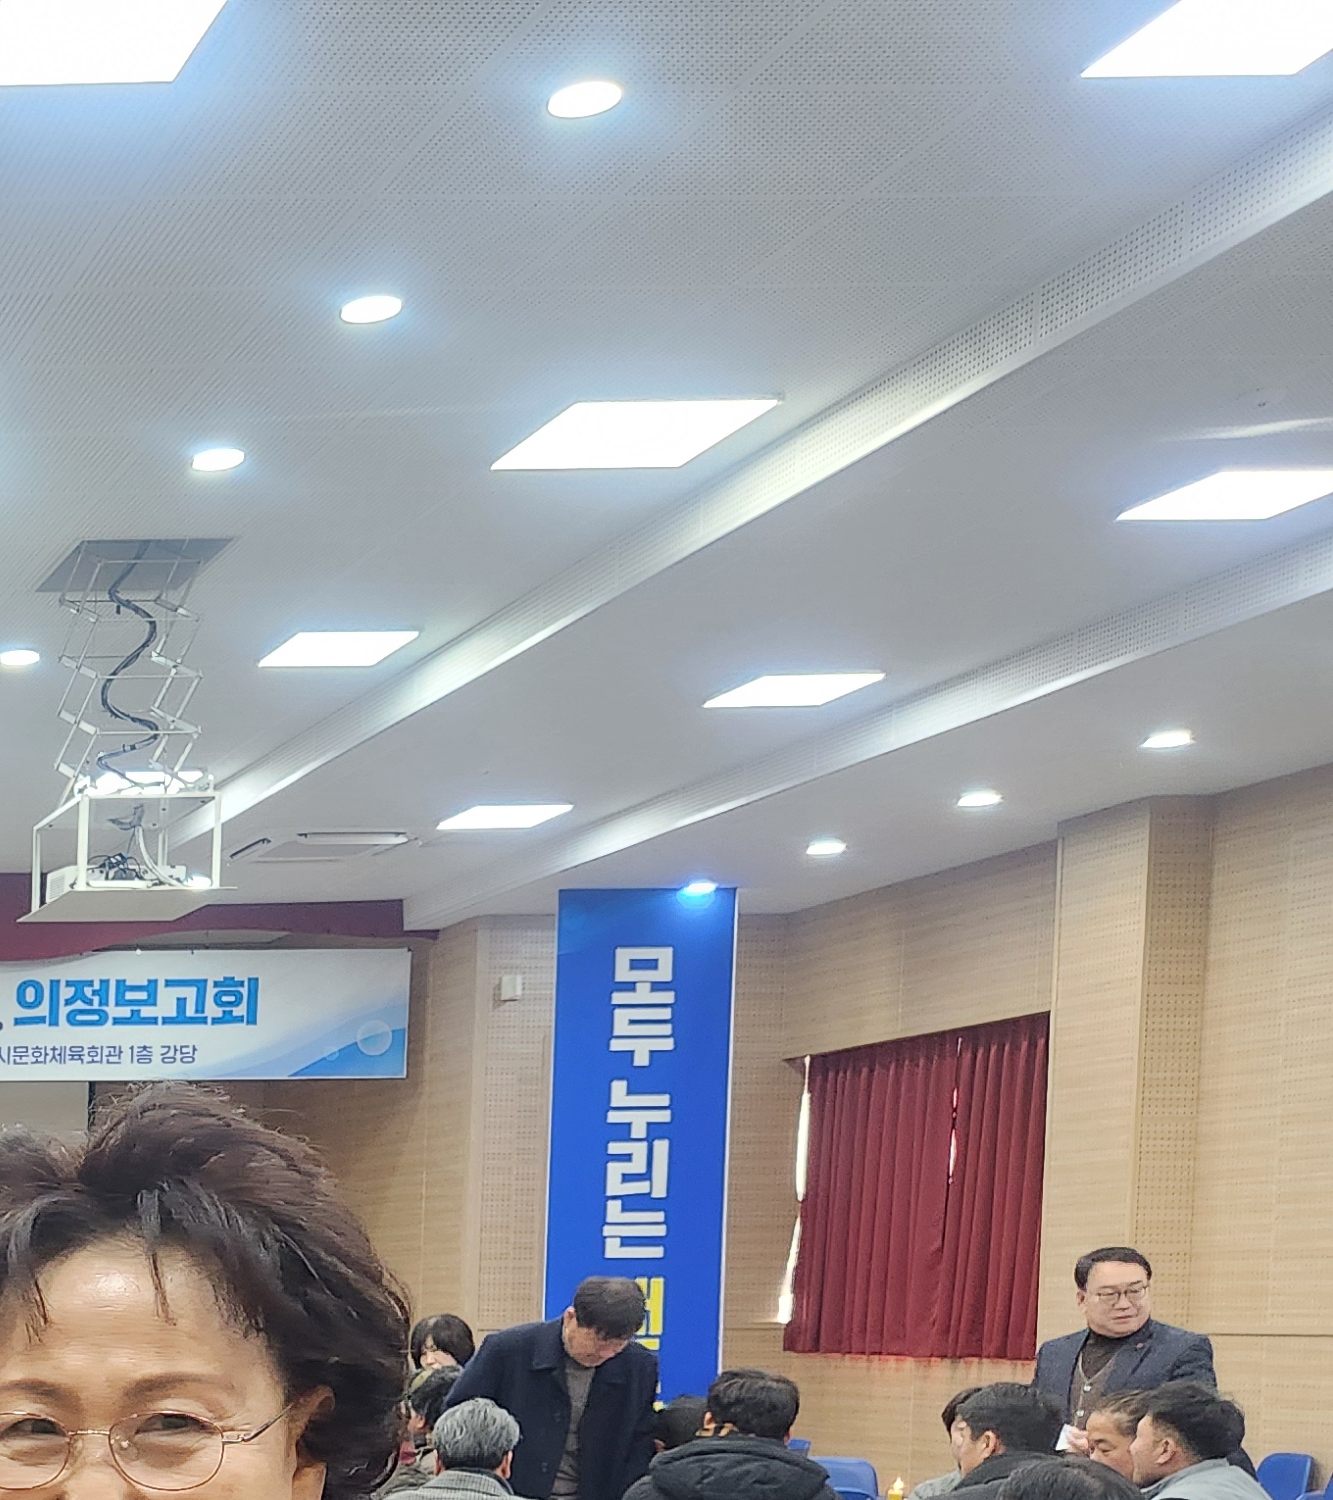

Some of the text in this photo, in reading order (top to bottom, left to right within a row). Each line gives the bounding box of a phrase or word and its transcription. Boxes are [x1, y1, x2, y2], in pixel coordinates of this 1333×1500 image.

[13, 976, 260, 1027] 의정보고회
[609, 946, 675, 1067] 모두
[129, 1045, 153, 1065] 1층
[160, 1044, 198, 1065] 강당
[603, 1079, 671, 1259] 누리는
